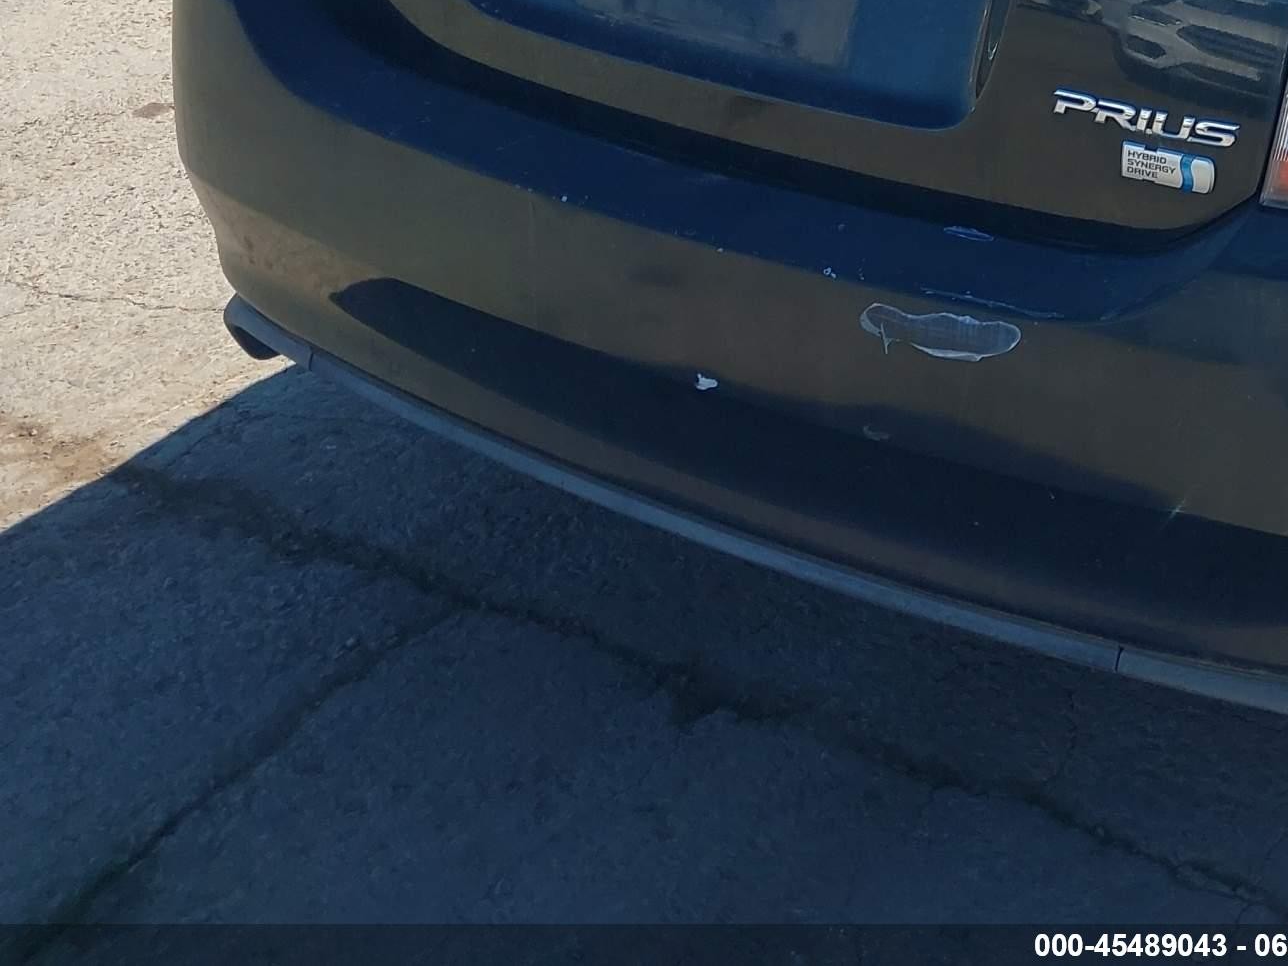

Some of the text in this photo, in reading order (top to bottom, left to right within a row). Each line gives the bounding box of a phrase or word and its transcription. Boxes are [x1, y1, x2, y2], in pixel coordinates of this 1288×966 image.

[1053, 88, 1241, 147] PRIUS
[1127, 150, 1167, 164] HYBRID
[1126, 166, 1158, 178] DRIVE
[1127, 158, 1176, 174] SYNERGY
